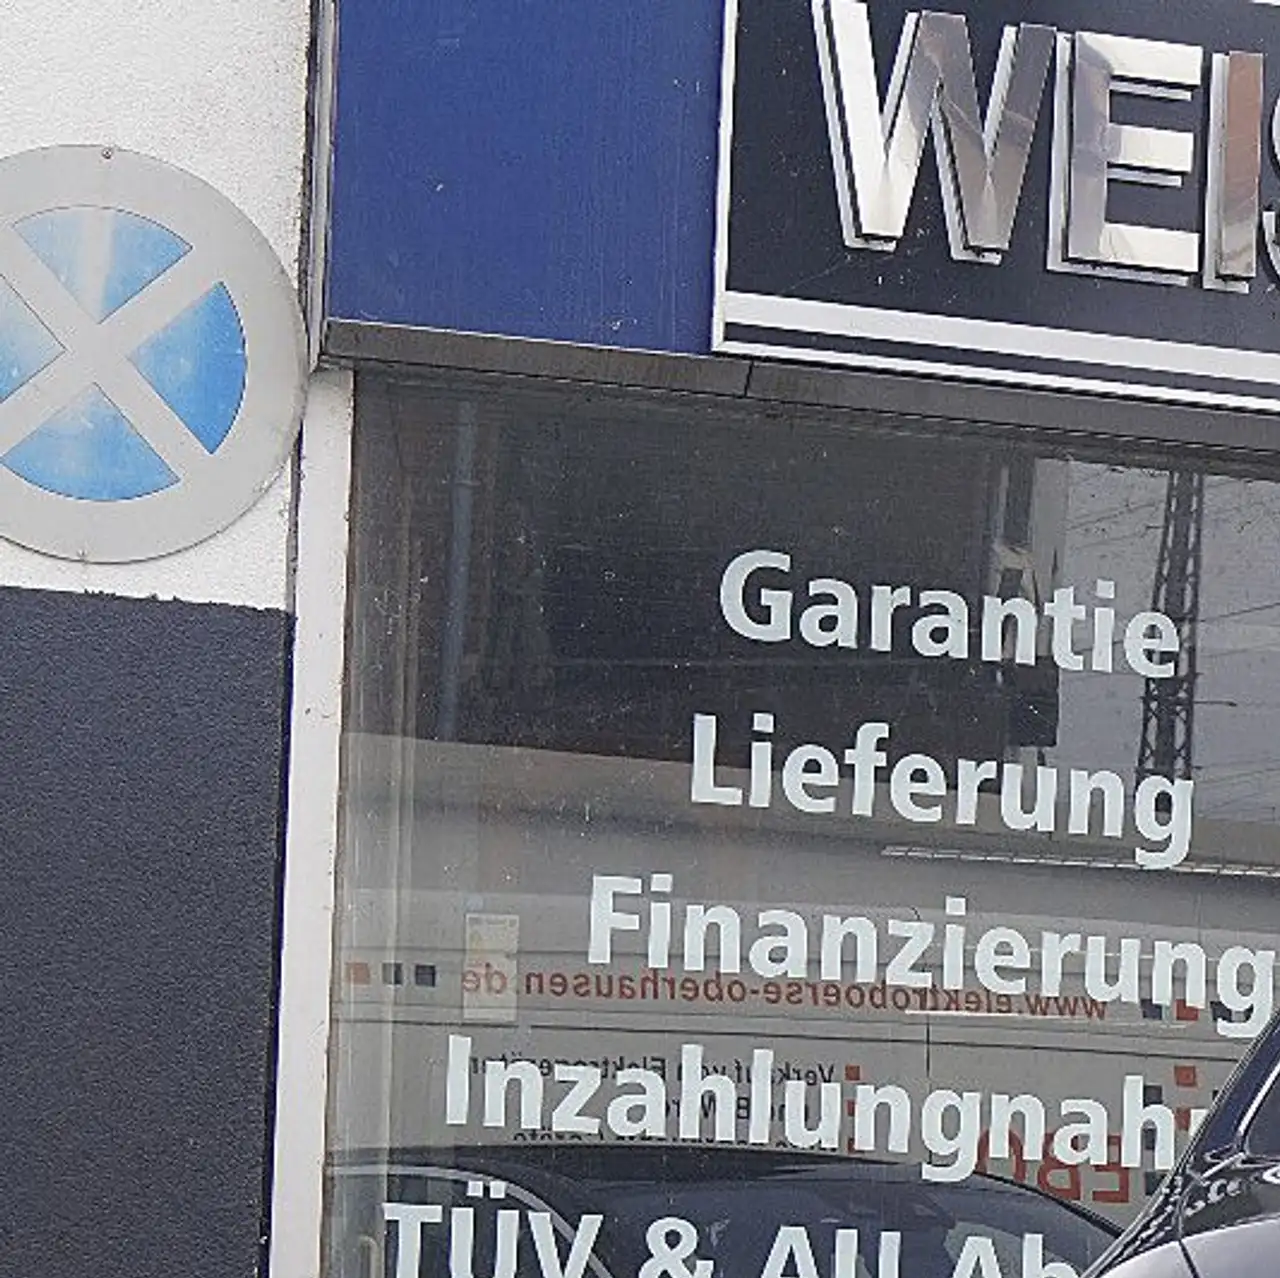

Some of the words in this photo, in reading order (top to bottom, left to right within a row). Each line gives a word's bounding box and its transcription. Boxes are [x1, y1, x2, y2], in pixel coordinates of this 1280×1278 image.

[719, 550, 1181, 680] Garantie
[690, 713, 1194, 870] Lieferung
[588, 873, 1276, 1038] Finanzierung
[444, 1034, 1208, 1182] Inzahlungnah
